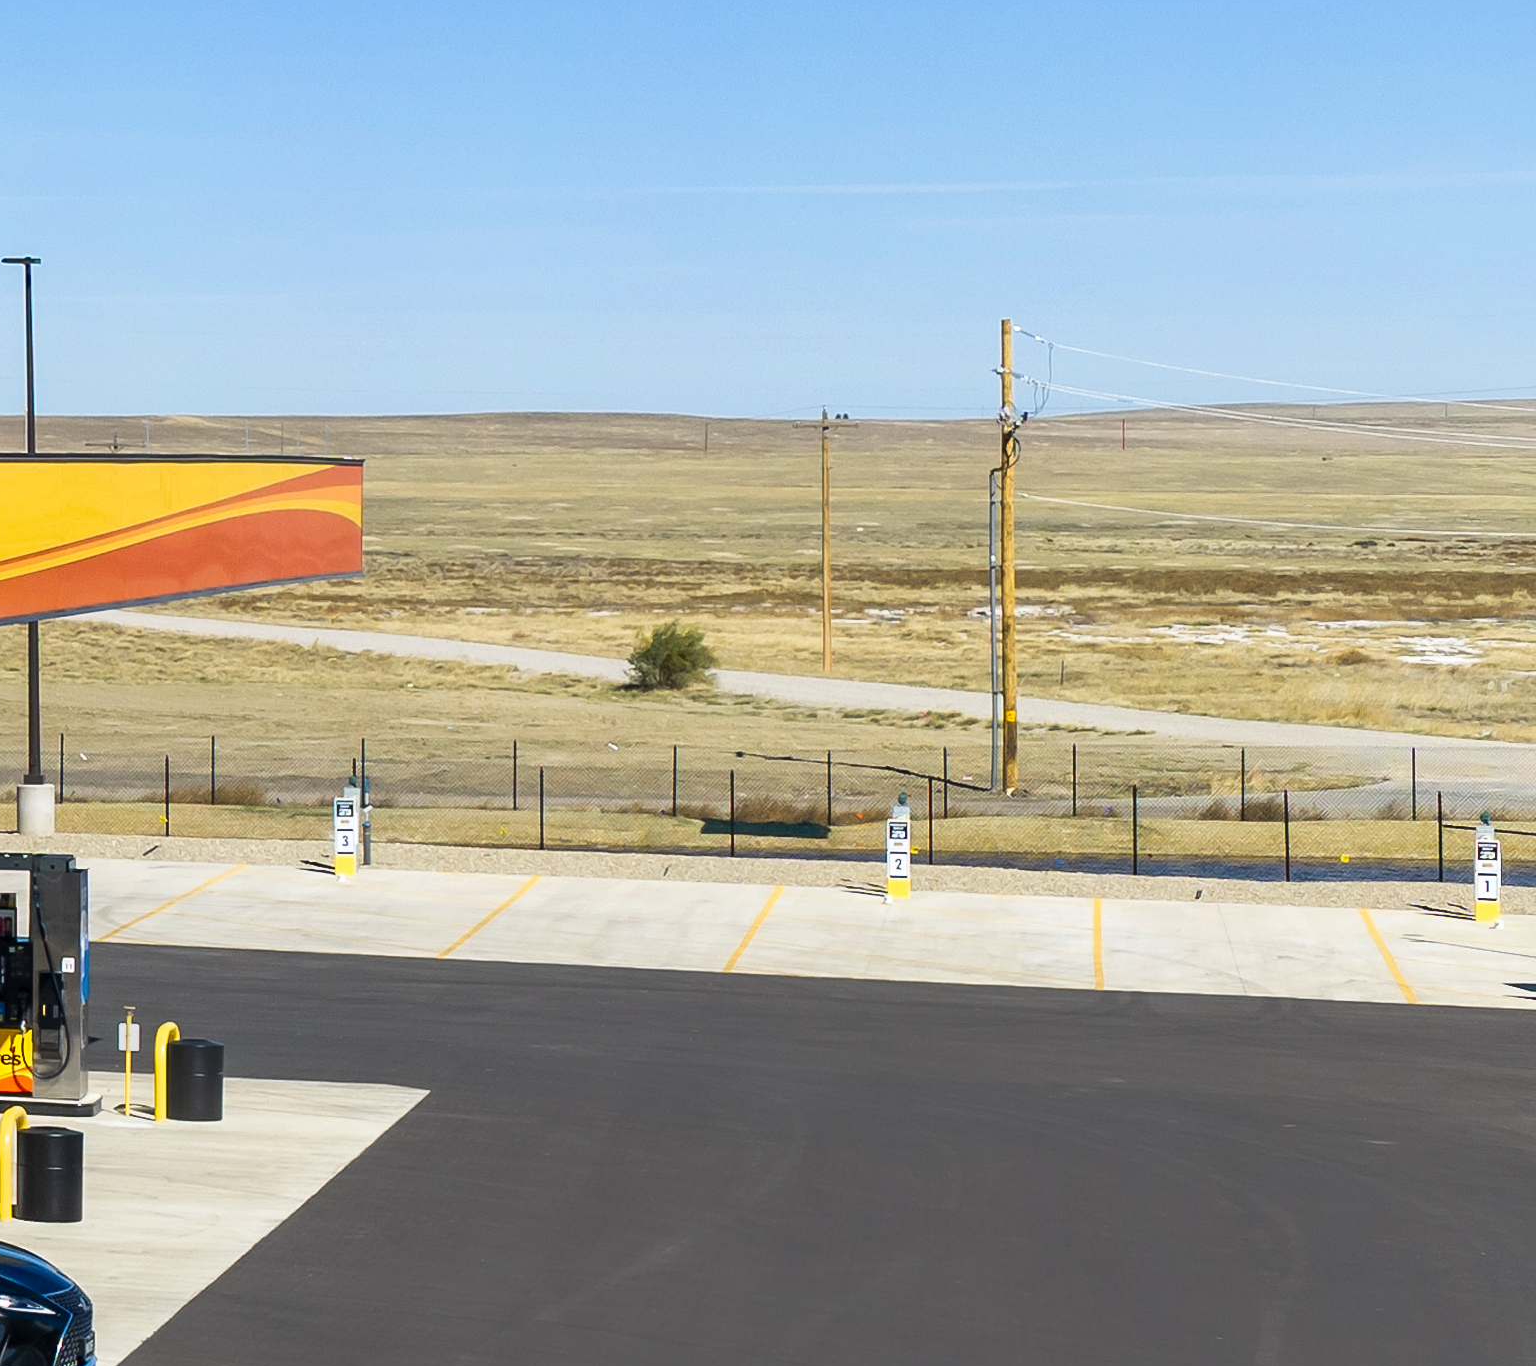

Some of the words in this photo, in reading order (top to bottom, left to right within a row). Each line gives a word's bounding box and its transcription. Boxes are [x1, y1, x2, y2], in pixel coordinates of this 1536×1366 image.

[342, 835, 349, 846] 3
[895, 858, 902, 870] 2
[1485, 880, 1490, 892] 1
